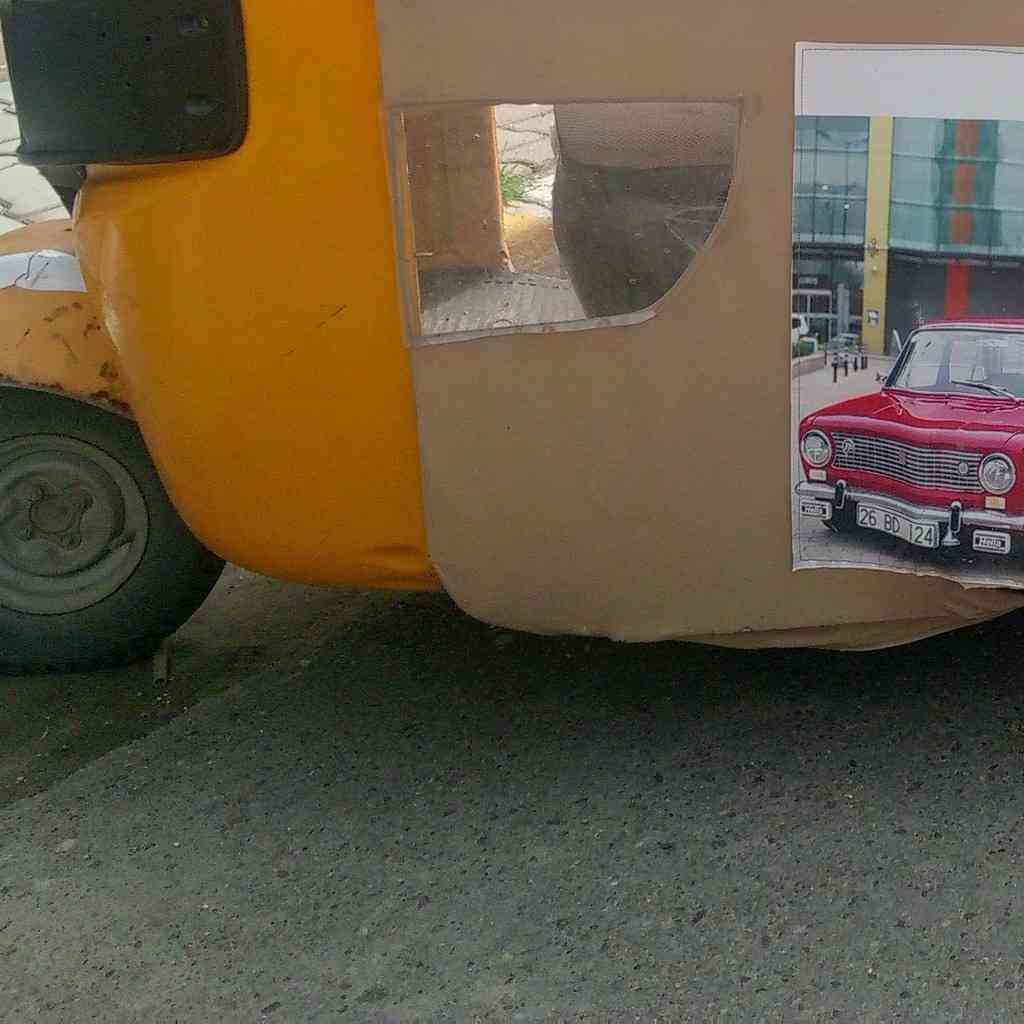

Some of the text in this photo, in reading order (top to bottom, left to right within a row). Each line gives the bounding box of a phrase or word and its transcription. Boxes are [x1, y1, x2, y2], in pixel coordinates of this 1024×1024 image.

[860, 508, 933, 545] 26 BD 124
